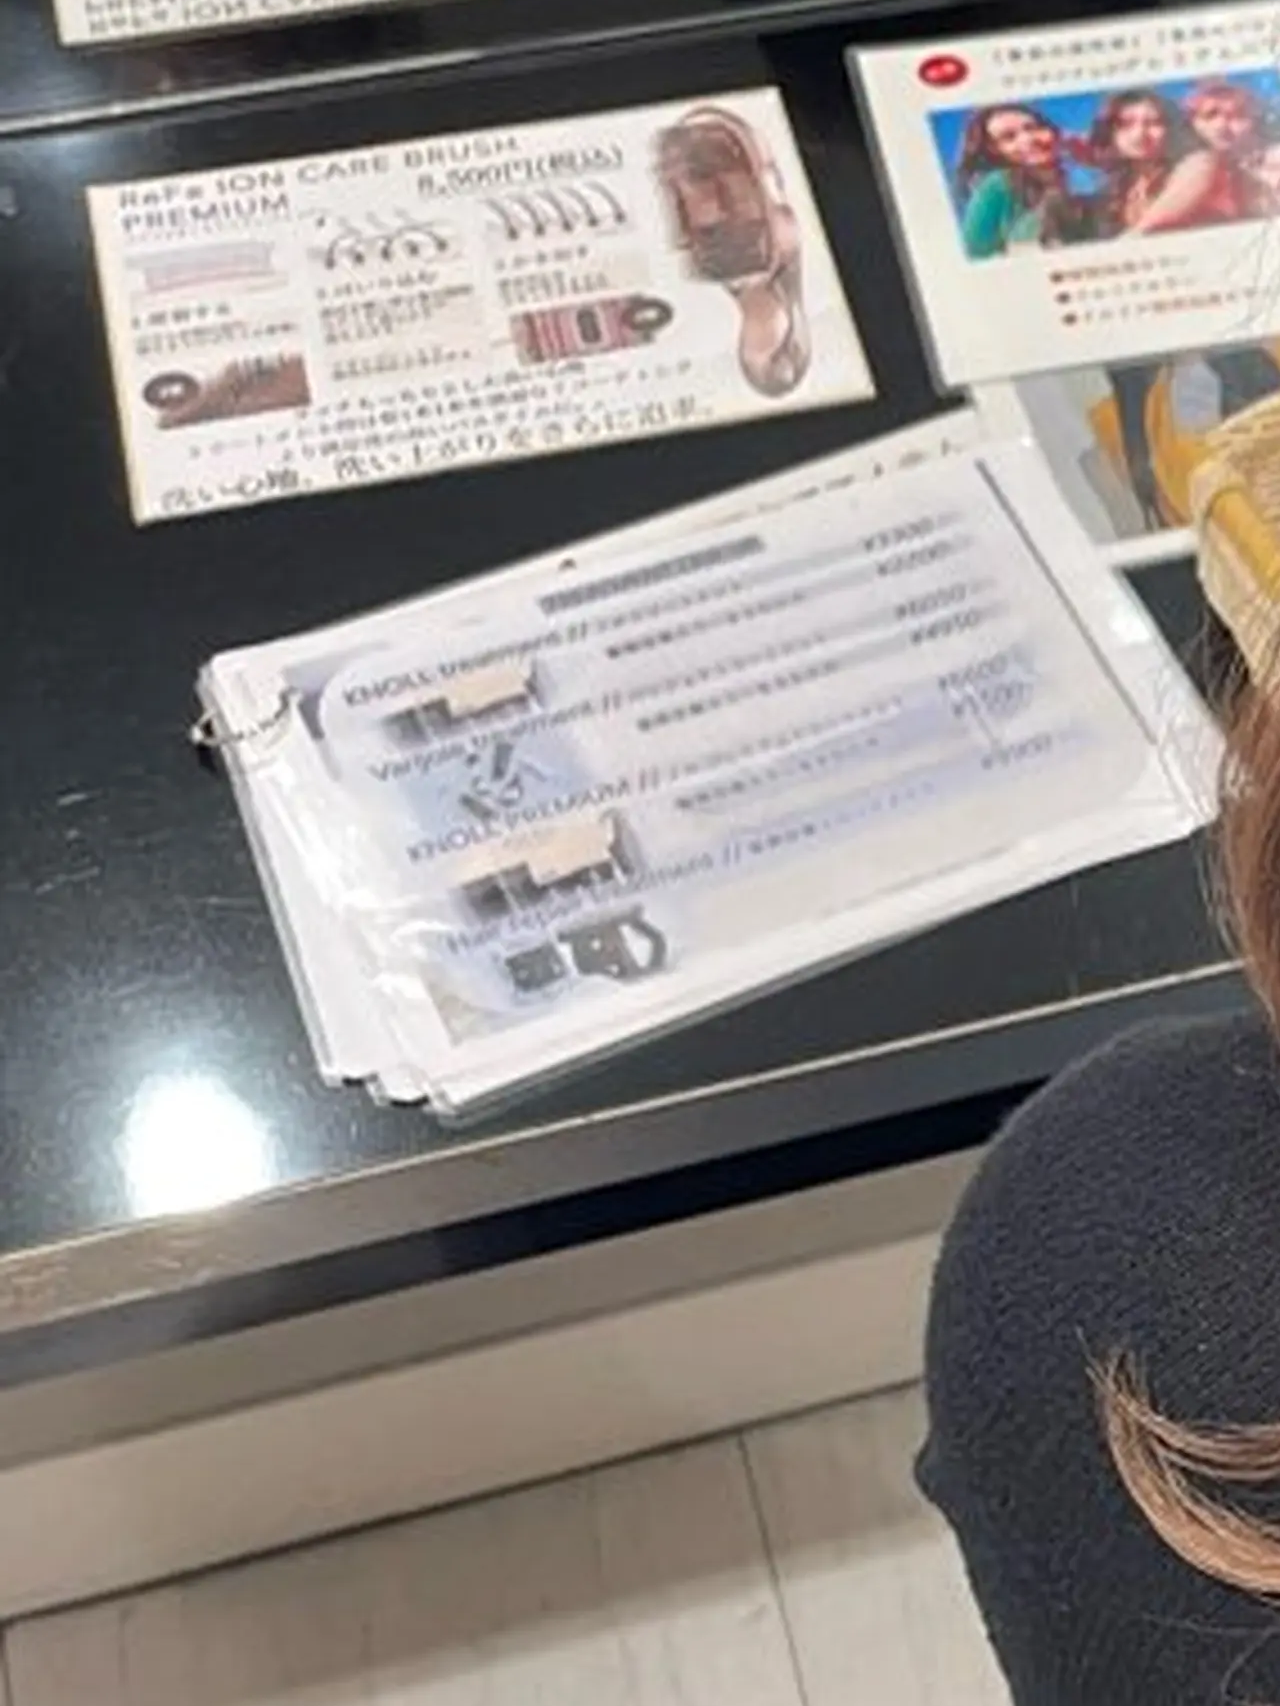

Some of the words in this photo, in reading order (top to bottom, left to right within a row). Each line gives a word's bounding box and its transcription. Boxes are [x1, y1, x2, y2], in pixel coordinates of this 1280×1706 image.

[215, 168, 286, 197] ION
[296, 154, 389, 185] CARE
[404, 136, 517, 169] BRUSH
[120, 192, 290, 232] PREMIUM
